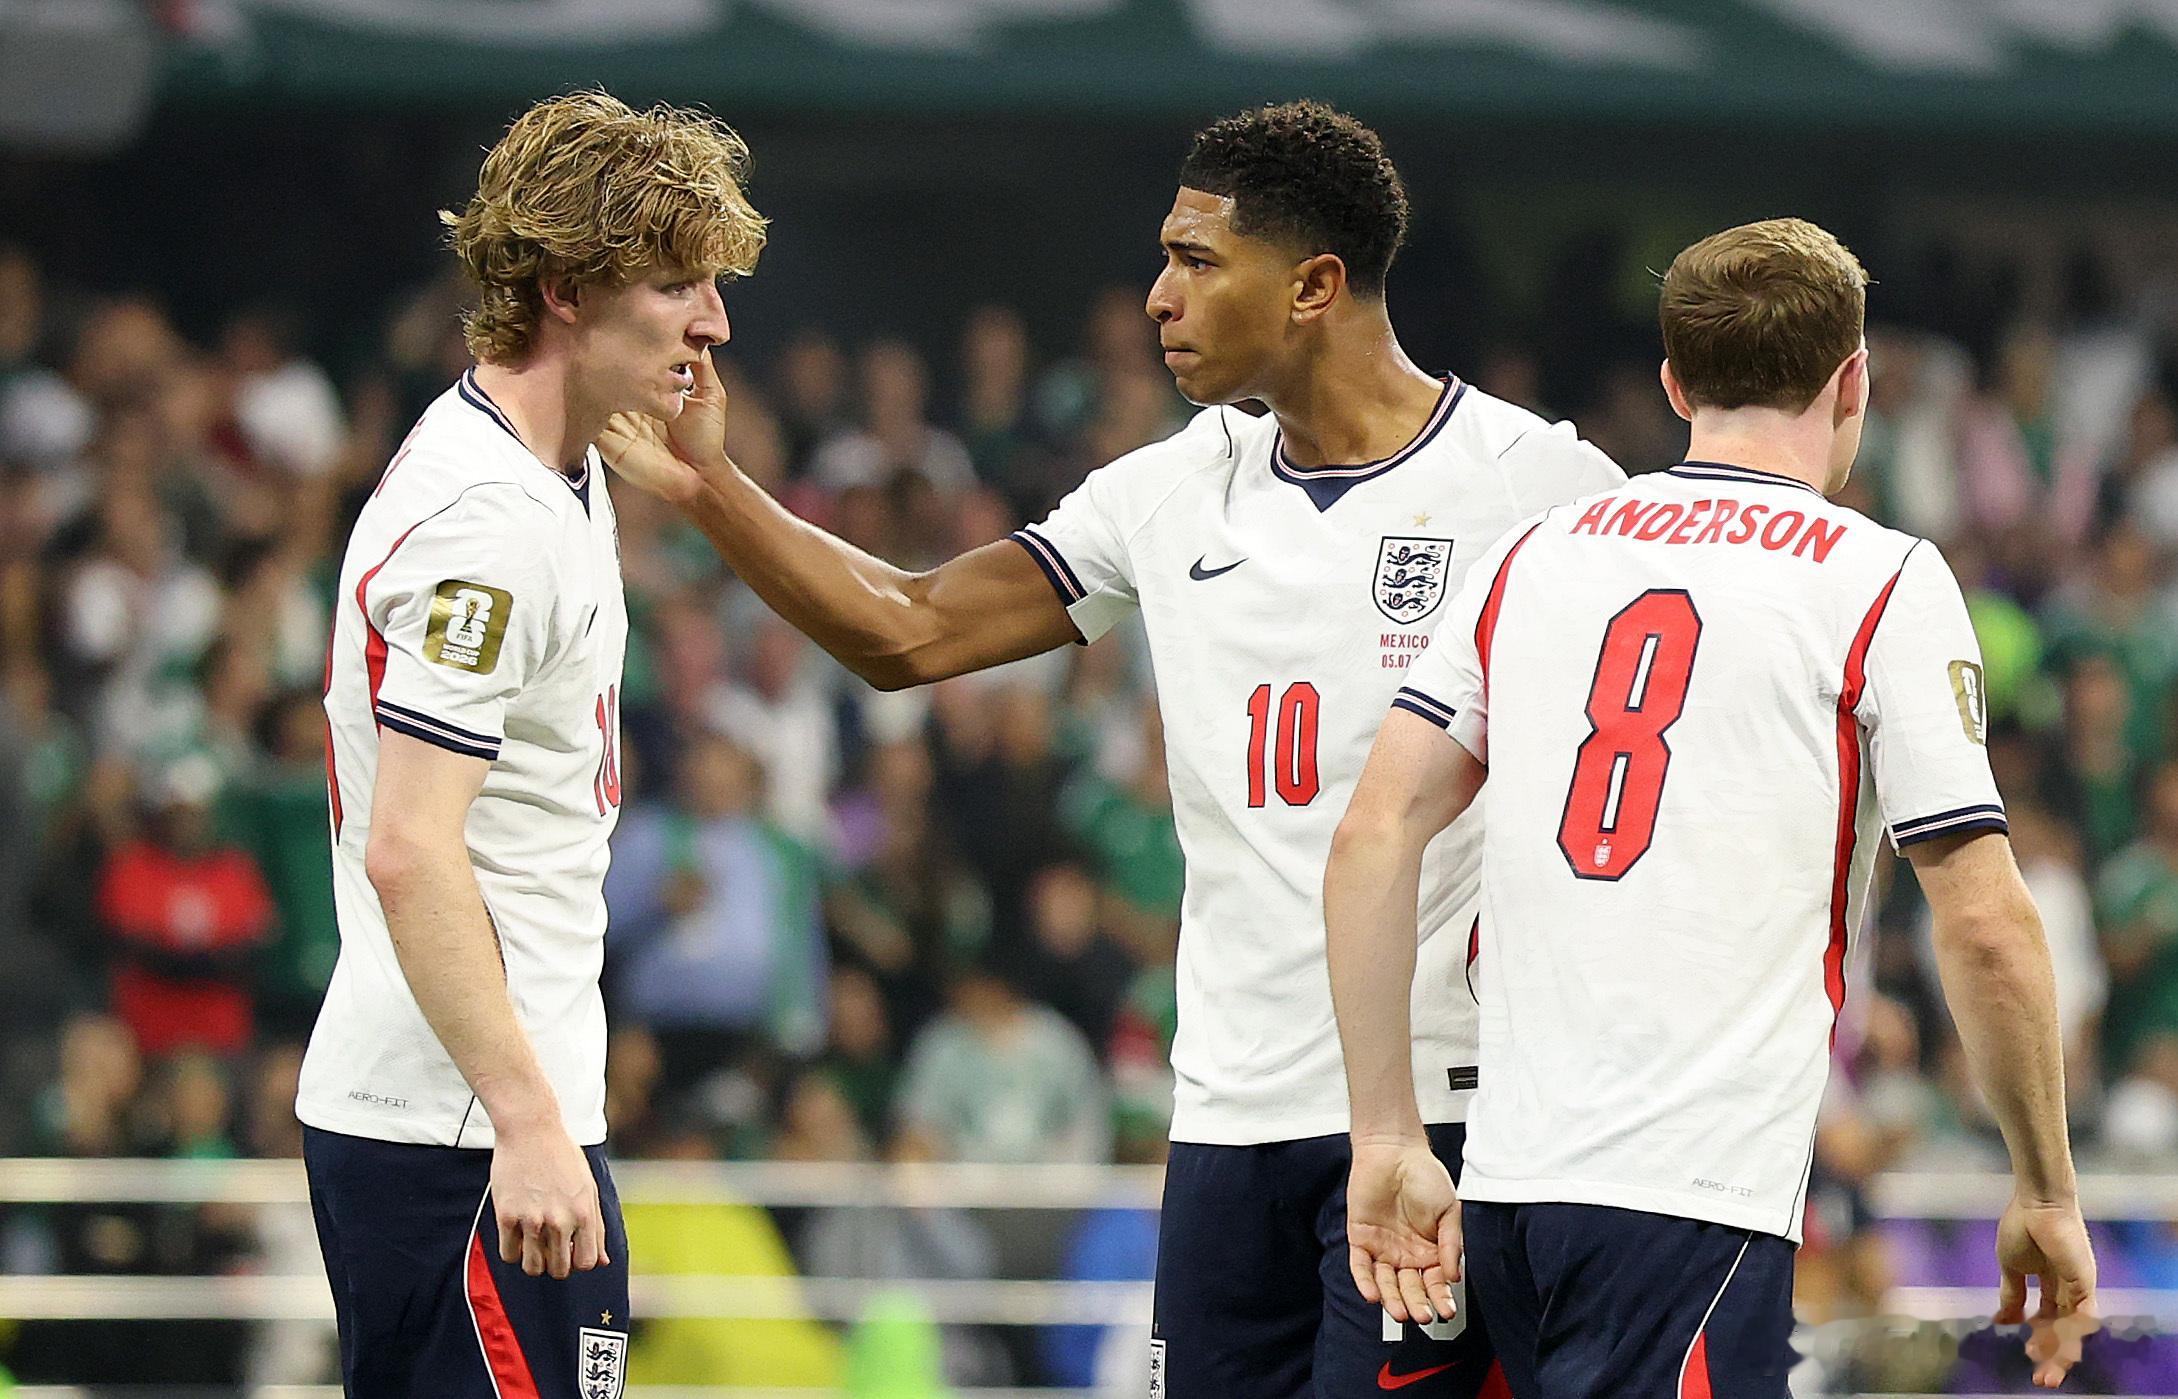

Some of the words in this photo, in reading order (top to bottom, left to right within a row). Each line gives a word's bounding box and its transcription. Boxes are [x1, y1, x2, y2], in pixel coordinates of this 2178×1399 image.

[1569, 496, 1848, 564] ANDERSON
[456, 633, 473, 642] FIFA
[1380, 634, 1429, 649] MEXICO
[440, 650, 478, 666] 2026
[466, 649, 480, 657] CUP
[1382, 654, 1420, 668] 05.07
[1557, 588, 1703, 882] 8
[1247, 682, 1320, 808] 10
[348, 1090, 408, 1109] AERO-FIT
[1692, 1178, 1753, 1197] AERO-FIT
